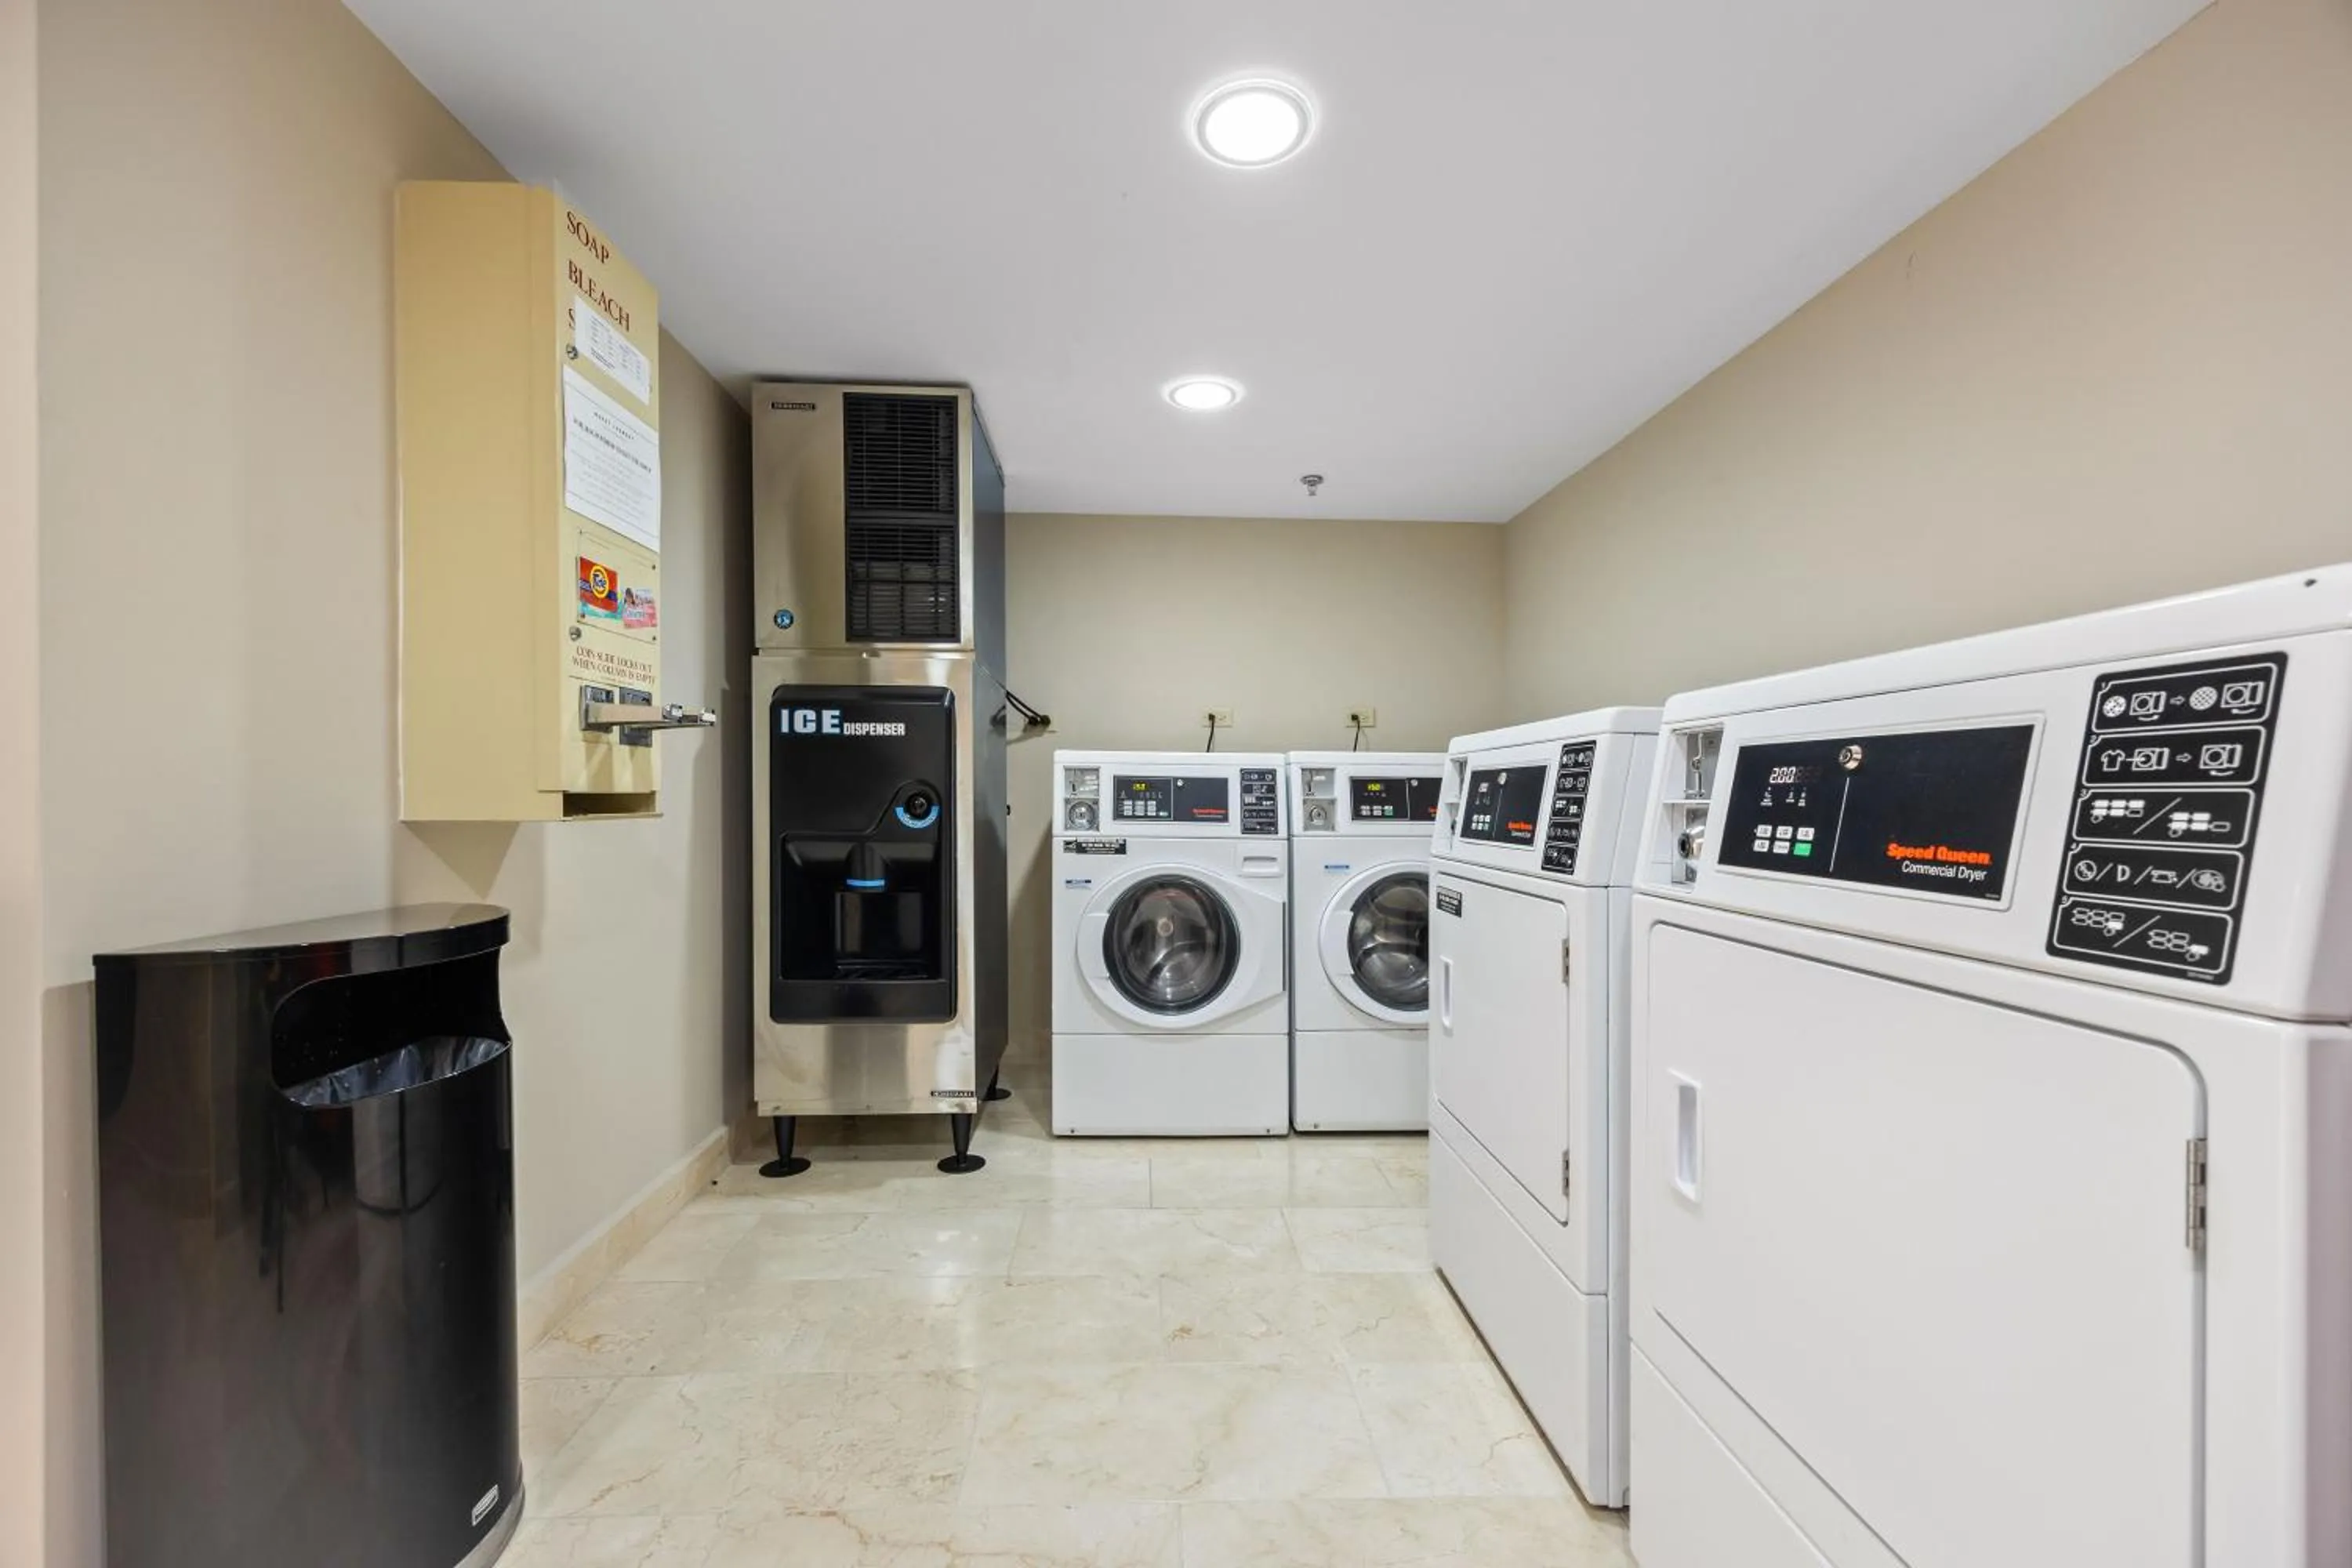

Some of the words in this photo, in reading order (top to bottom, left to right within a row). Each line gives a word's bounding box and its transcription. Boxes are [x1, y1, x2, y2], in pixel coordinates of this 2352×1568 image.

[567, 210, 609, 264] SOAP
[568, 260, 630, 332] BLEACH
[780, 709, 841, 733] ICE
[843, 722, 906, 736] DISPENSER
[1886, 843, 1936, 859] Speed
[1936, 846, 1991, 865] Queen
[1901, 861, 1956, 878] Commercial
[1958, 866, 1988, 883] Dryer
[2116, 865, 2131, 883] D
